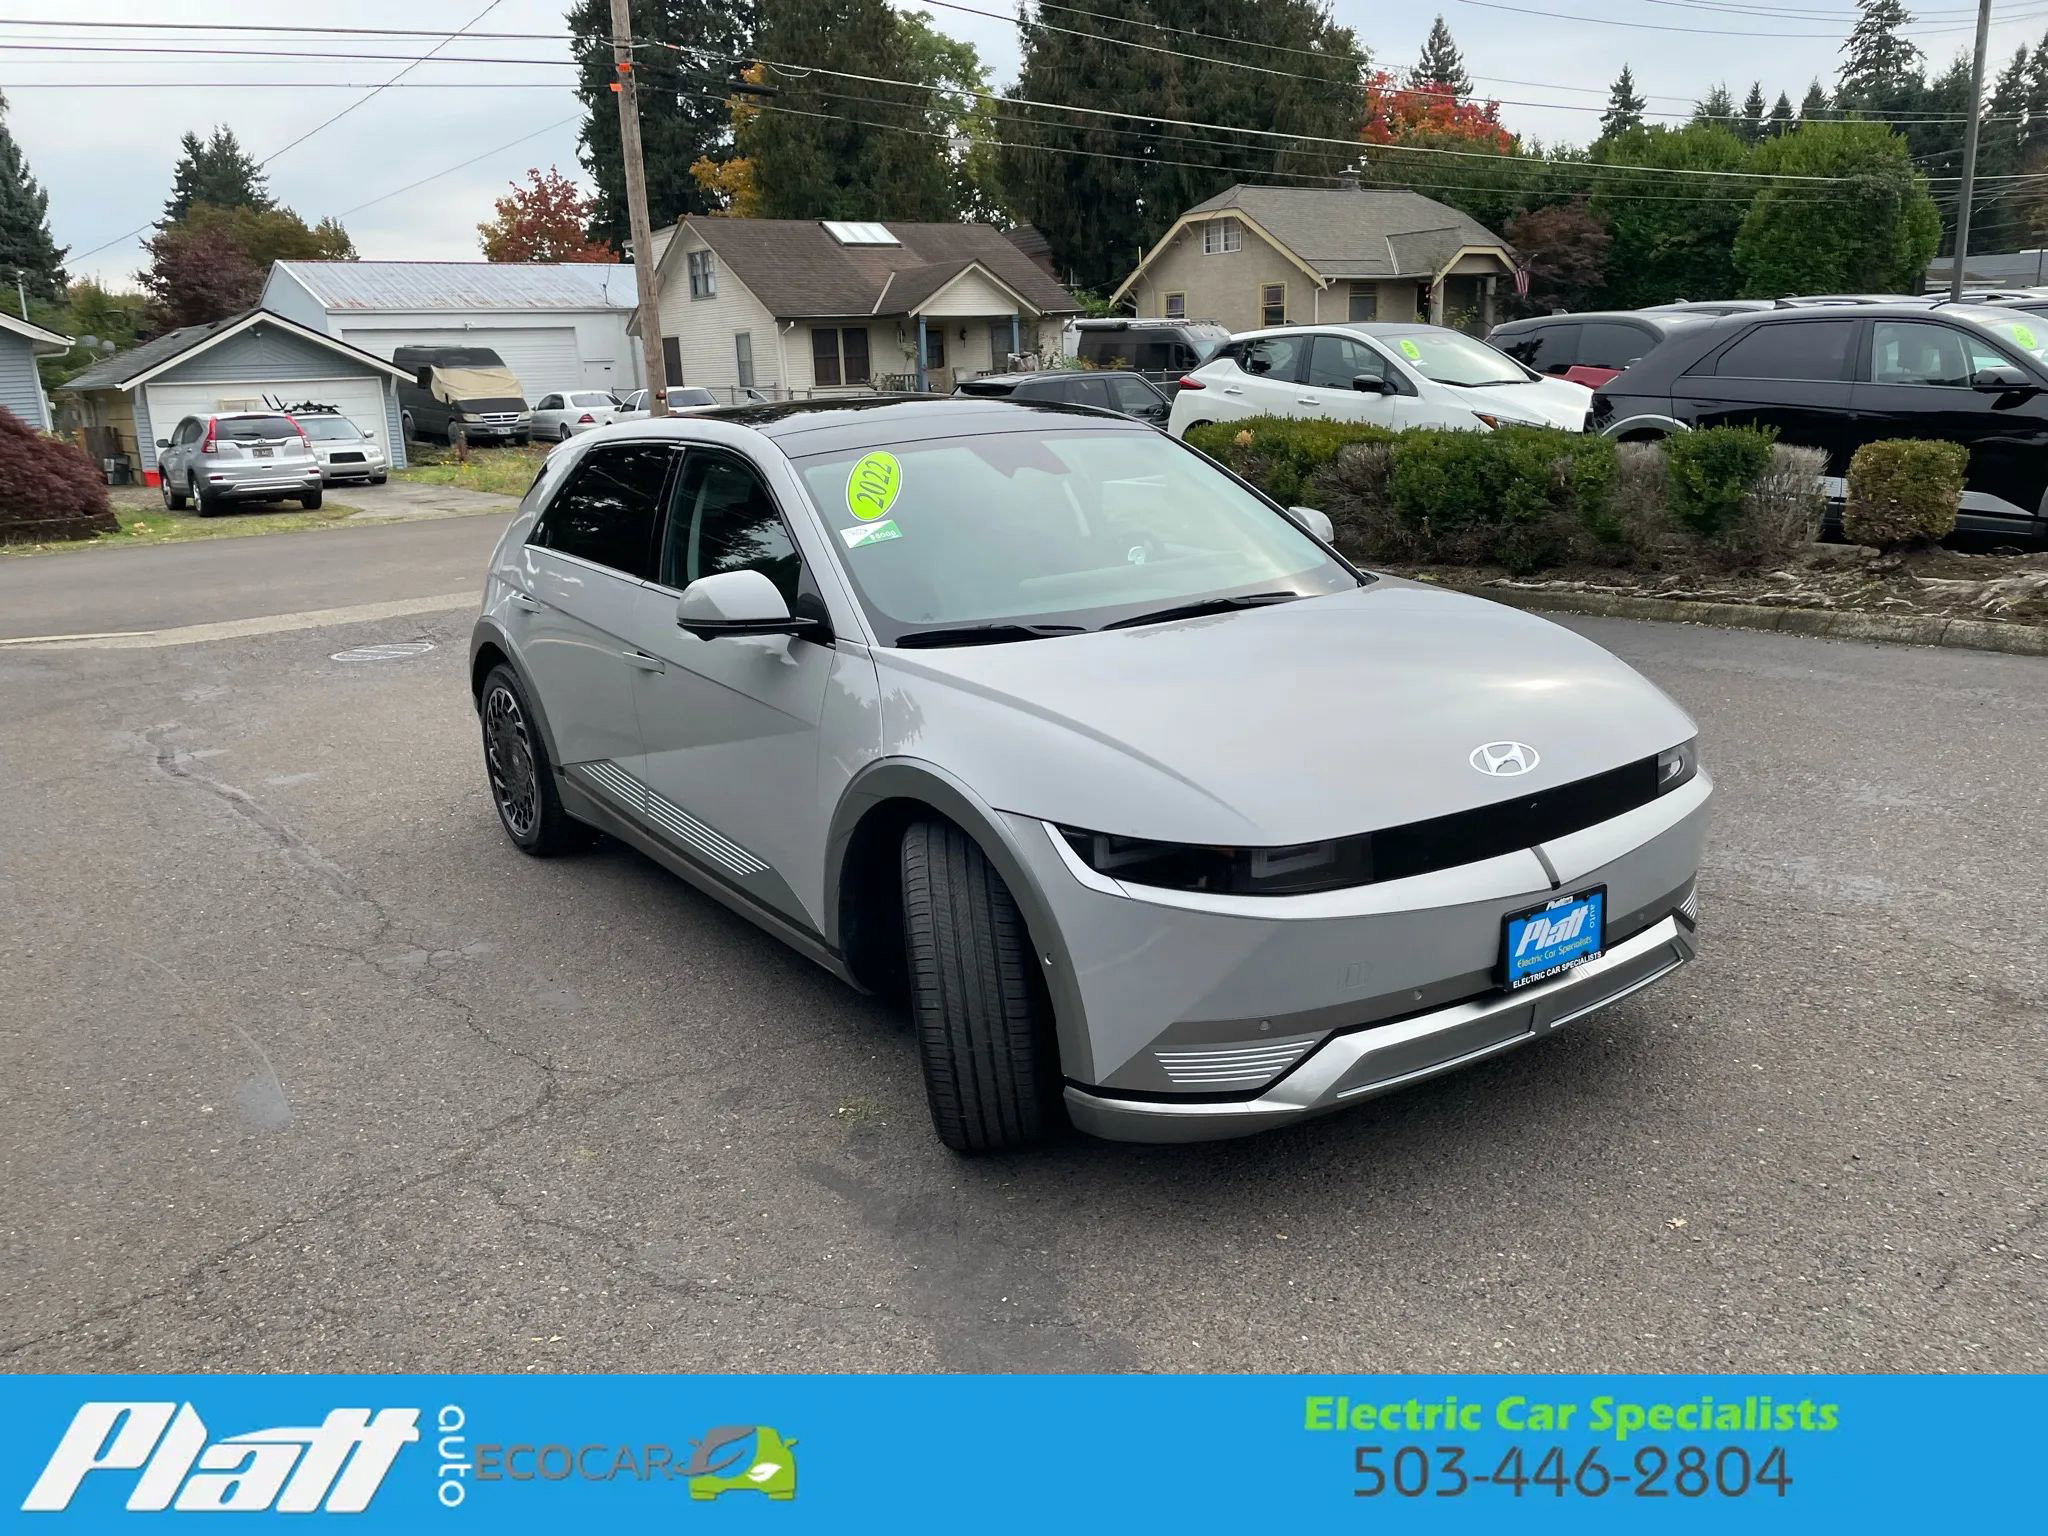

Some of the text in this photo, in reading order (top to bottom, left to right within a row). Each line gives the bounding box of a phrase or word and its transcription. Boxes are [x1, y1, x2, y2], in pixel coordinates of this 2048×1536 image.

[857, 460, 892, 509] 2022
[1514, 904, 1589, 957] Platt
[1513, 951, 1602, 988] ELECTRIC CAR SPECIALISTS
[1544, 949, 1556, 960] Car
